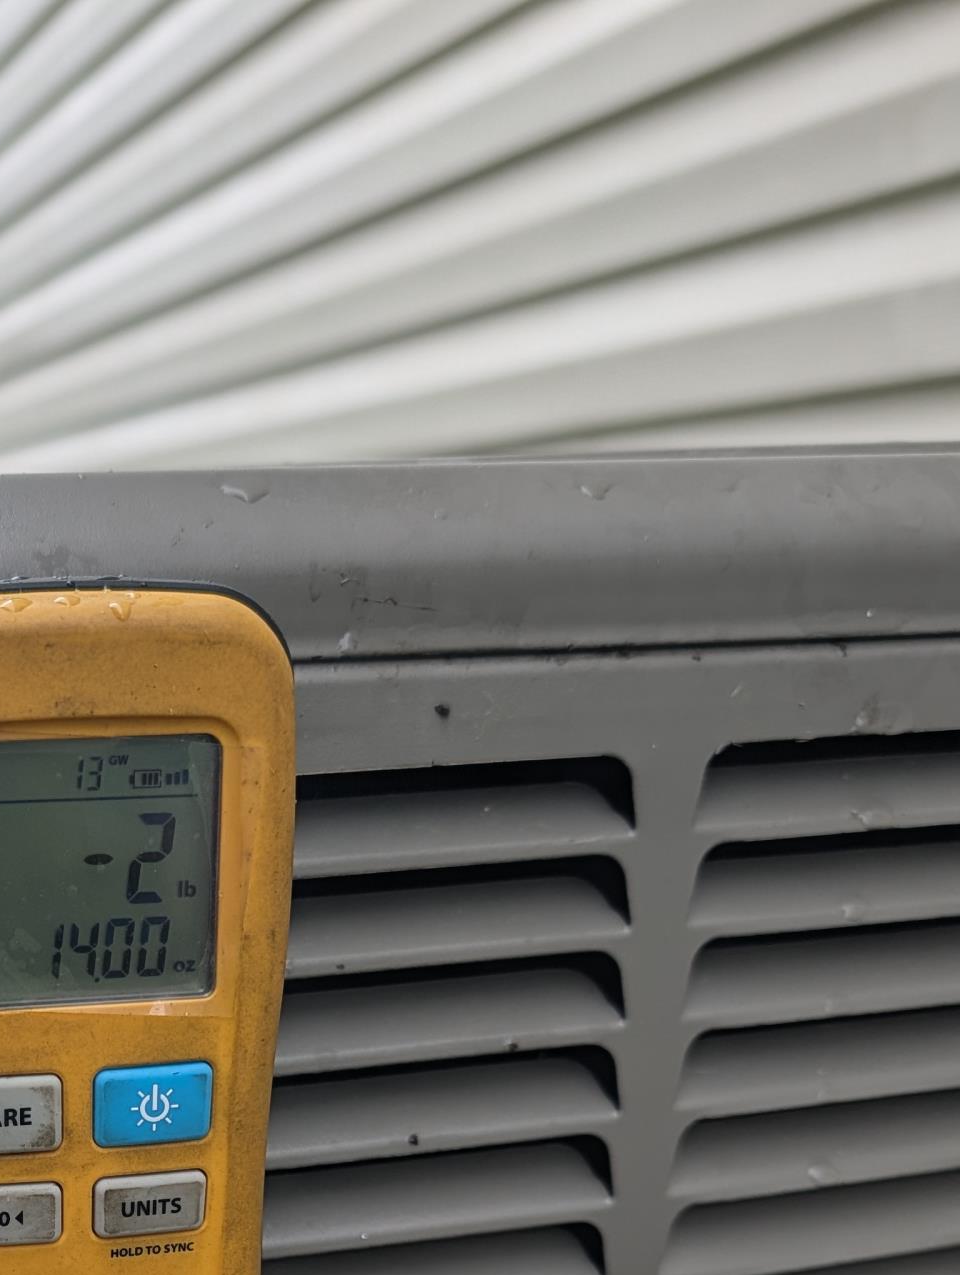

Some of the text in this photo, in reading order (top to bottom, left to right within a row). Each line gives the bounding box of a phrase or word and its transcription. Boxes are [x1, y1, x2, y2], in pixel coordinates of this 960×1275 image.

[77, 757, 103, 791] 13
[177, 881, 197, 898] lb
[173, 959, 196, 972] oz
[121, 1198, 182, 1218] UNITS
[110, 1242, 195, 1259] HOLD TO SYNC
